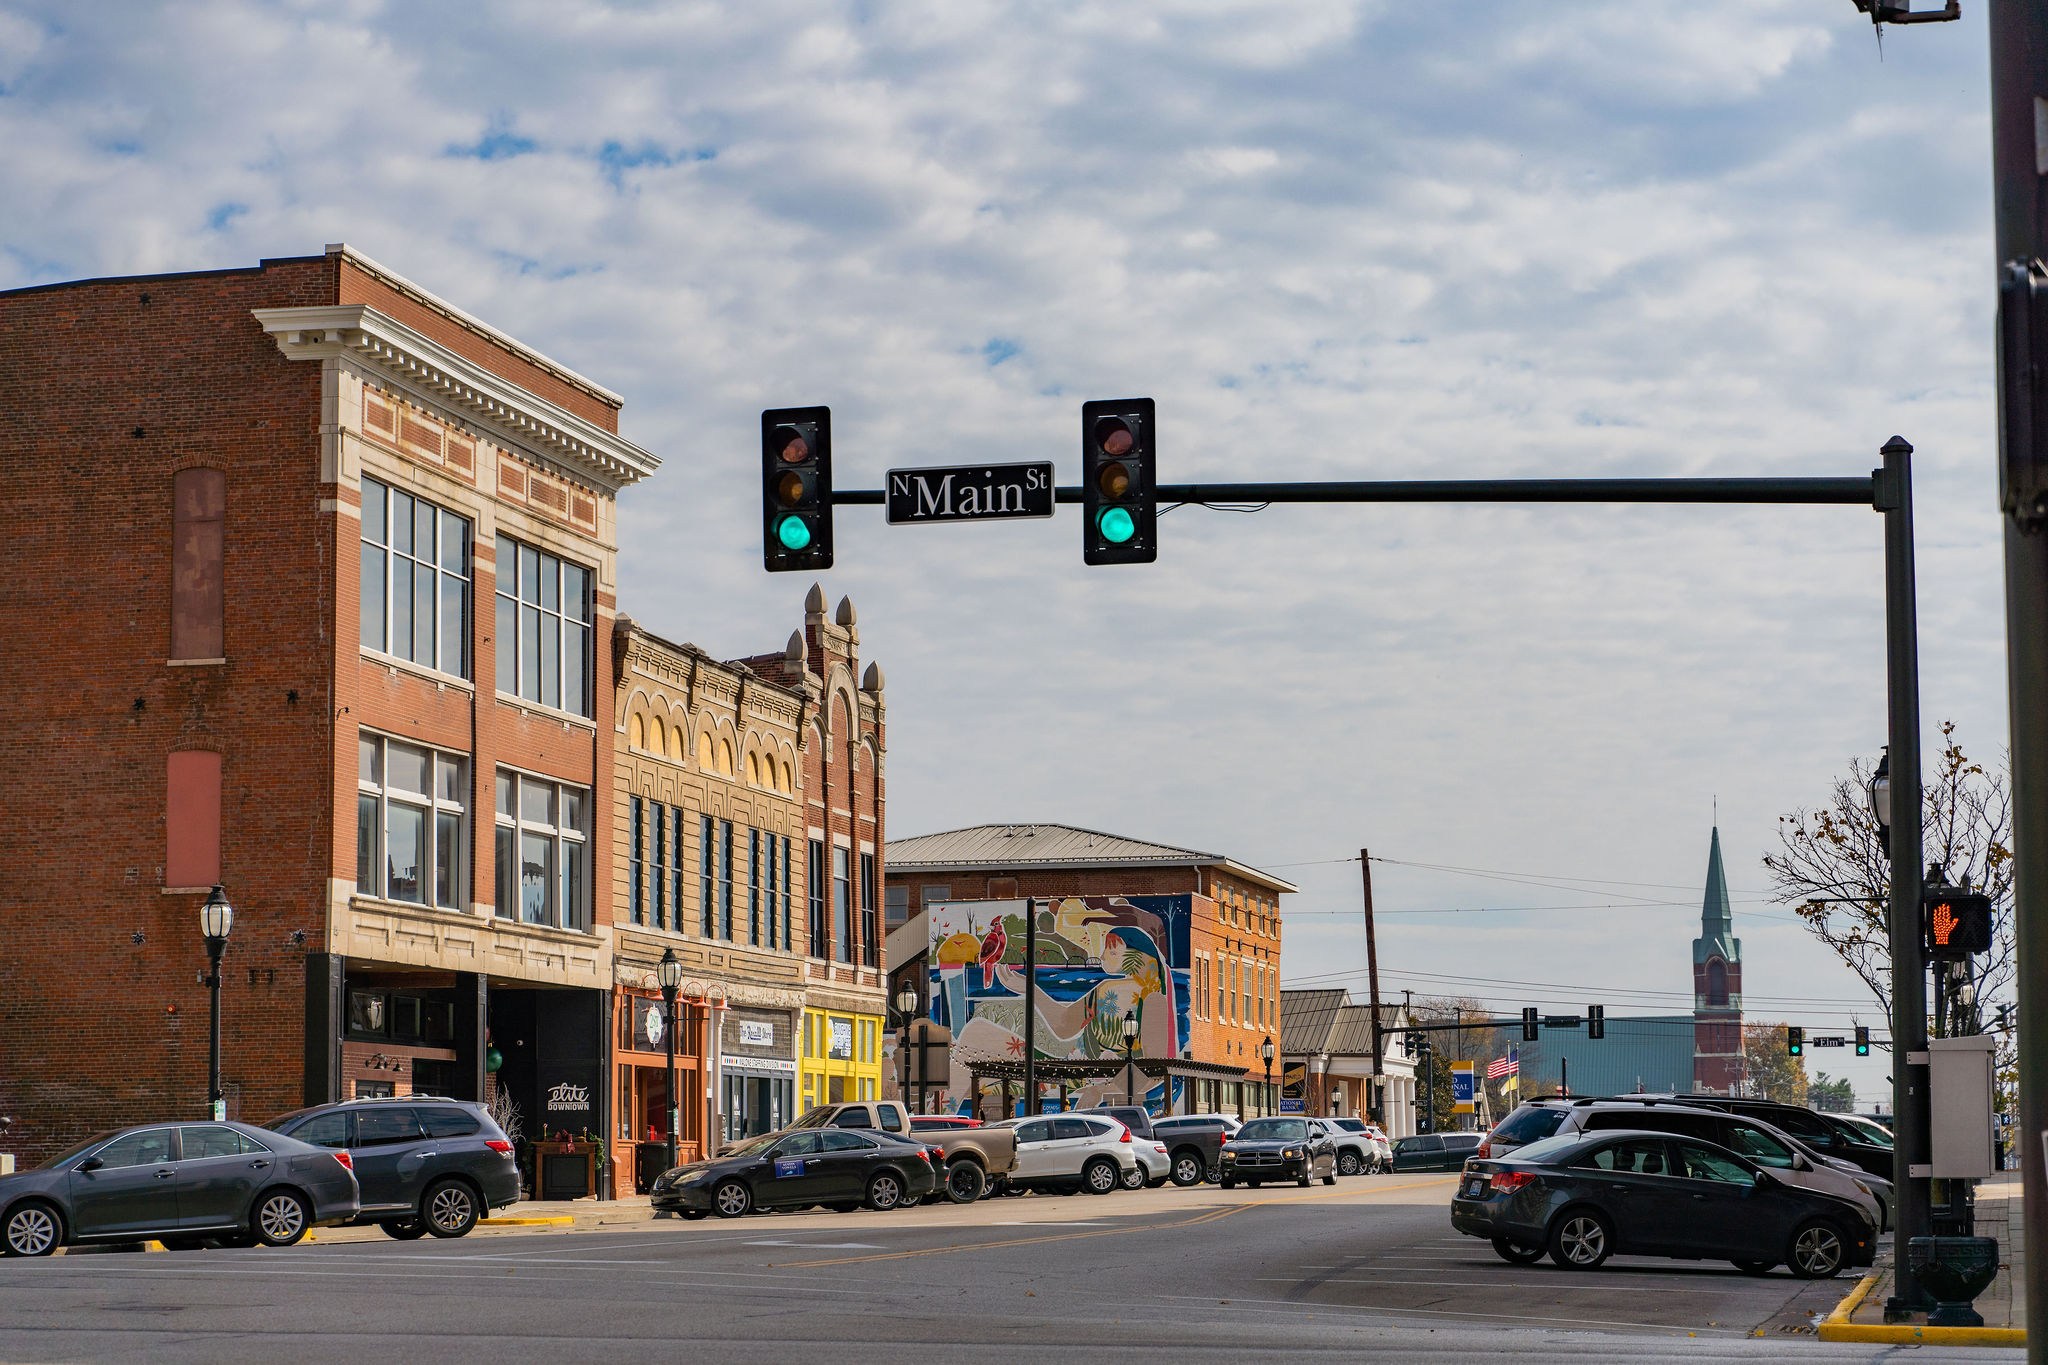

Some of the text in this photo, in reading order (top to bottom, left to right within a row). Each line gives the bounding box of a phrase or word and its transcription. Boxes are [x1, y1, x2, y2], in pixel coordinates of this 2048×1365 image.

[891, 468, 1048, 516] N Main St
[1820, 1038, 1838, 1047] Elm
[548, 1082, 589, 1103] elite
[547, 1101, 590, 1111] DOWNTOWN
